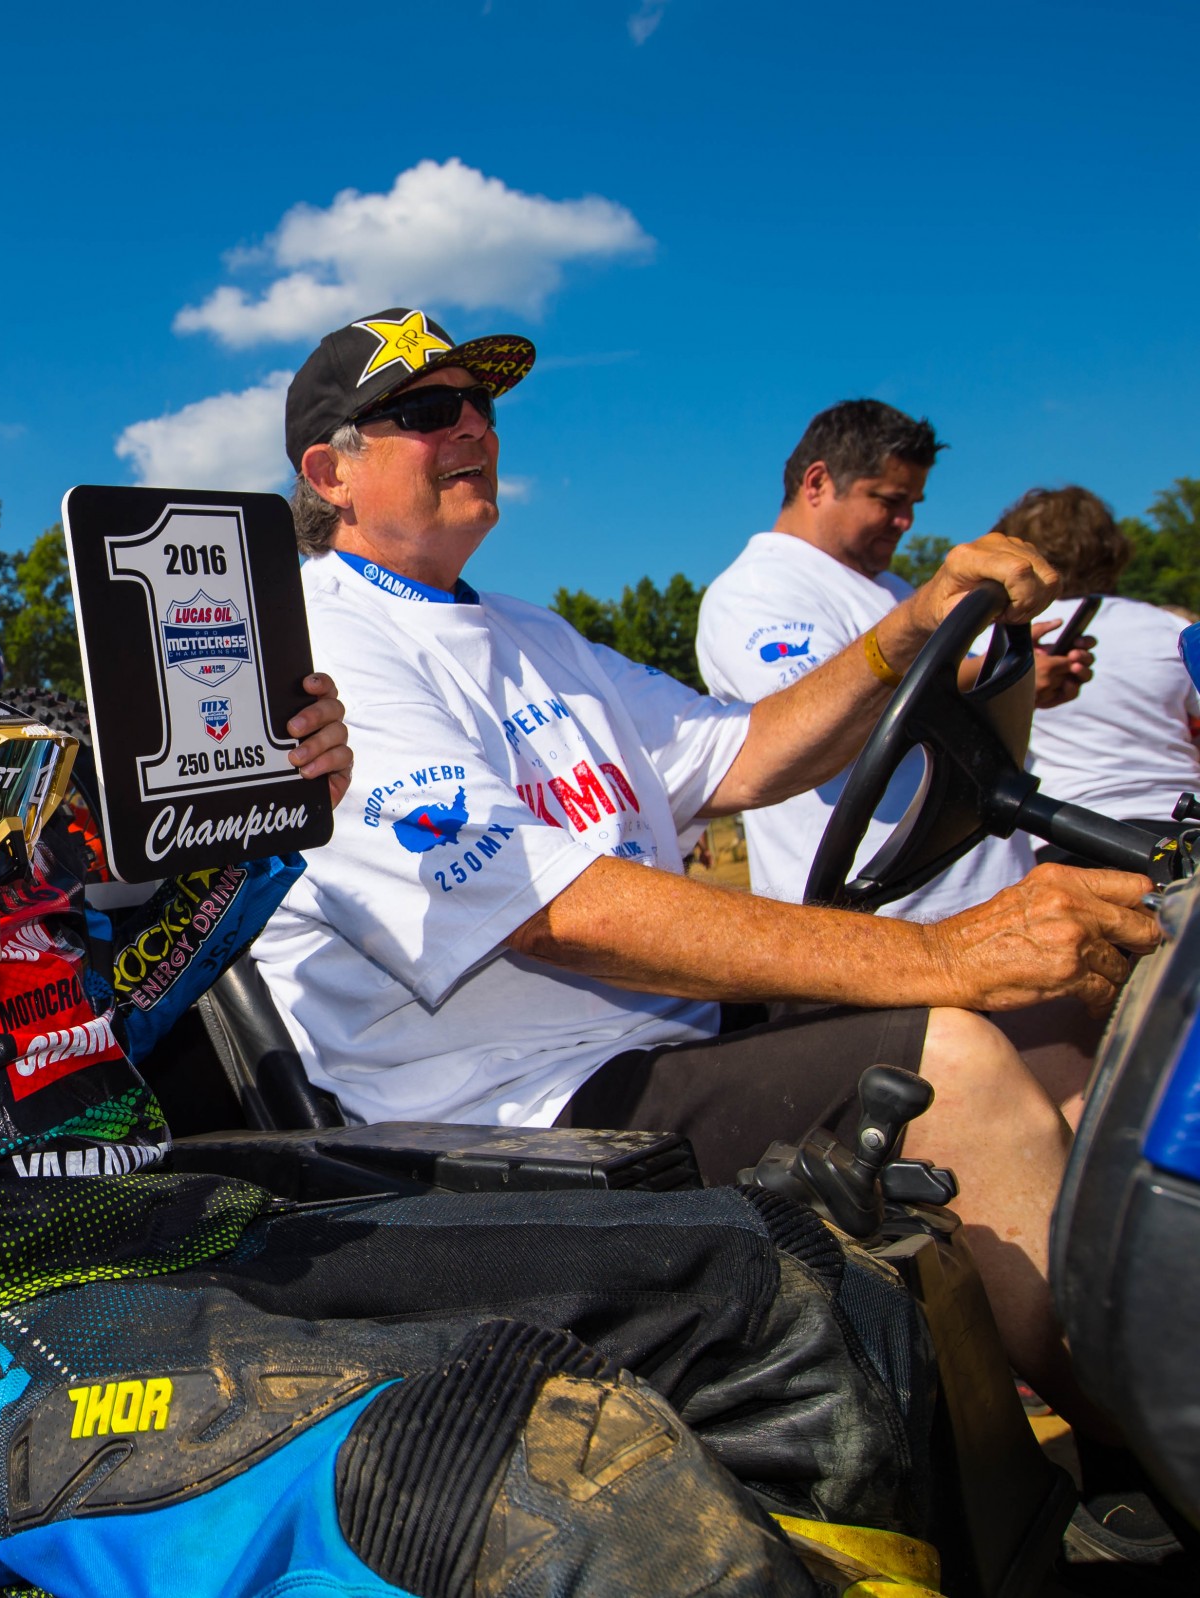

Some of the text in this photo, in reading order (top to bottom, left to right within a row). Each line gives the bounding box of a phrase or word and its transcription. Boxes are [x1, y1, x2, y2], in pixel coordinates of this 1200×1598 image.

[163, 544, 228, 576] 2016
[175, 607, 232, 623] LUCAS OIL
[167, 635, 247, 651] MOTOCROSS
[168, 648, 248, 657] CHAMPIONSHIP
[199, 664, 216, 675] AMA
[176, 745, 266, 777] 250 CLASS
[409, 765, 466, 787] WEBB
[145, 802, 308, 862] Champion
[131, 933, 195, 1009] ENERGY
[192, 864, 244, 934] DRINK
[67, 1376, 174, 1440] THOR
